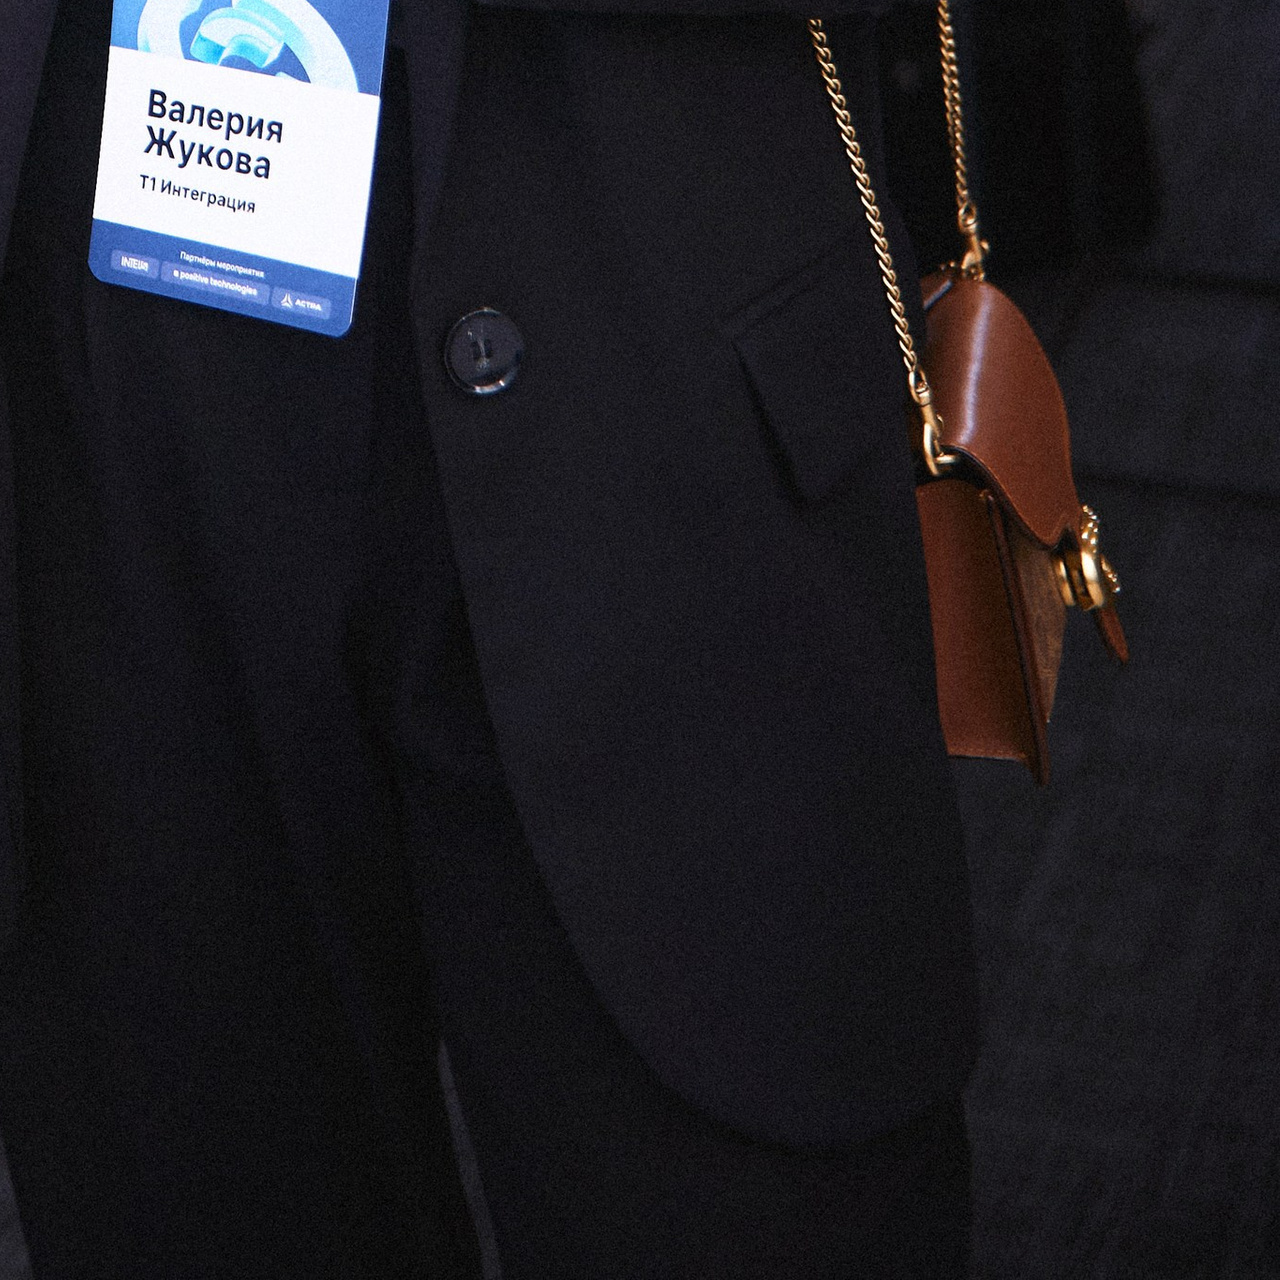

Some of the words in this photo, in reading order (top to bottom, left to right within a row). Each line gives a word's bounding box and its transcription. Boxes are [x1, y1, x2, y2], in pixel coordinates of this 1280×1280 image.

[148, 89, 283, 143] Валерия
[143, 125, 271, 179] Жукова
[139, 174, 157, 192] Т1
[160, 179, 256, 213] Интеграция
[180, 251, 216, 269] Партнёры
[217, 260, 266, 278] мероприятия
[180, 270, 209, 285] positive
[210, 274, 258, 297] technologies
